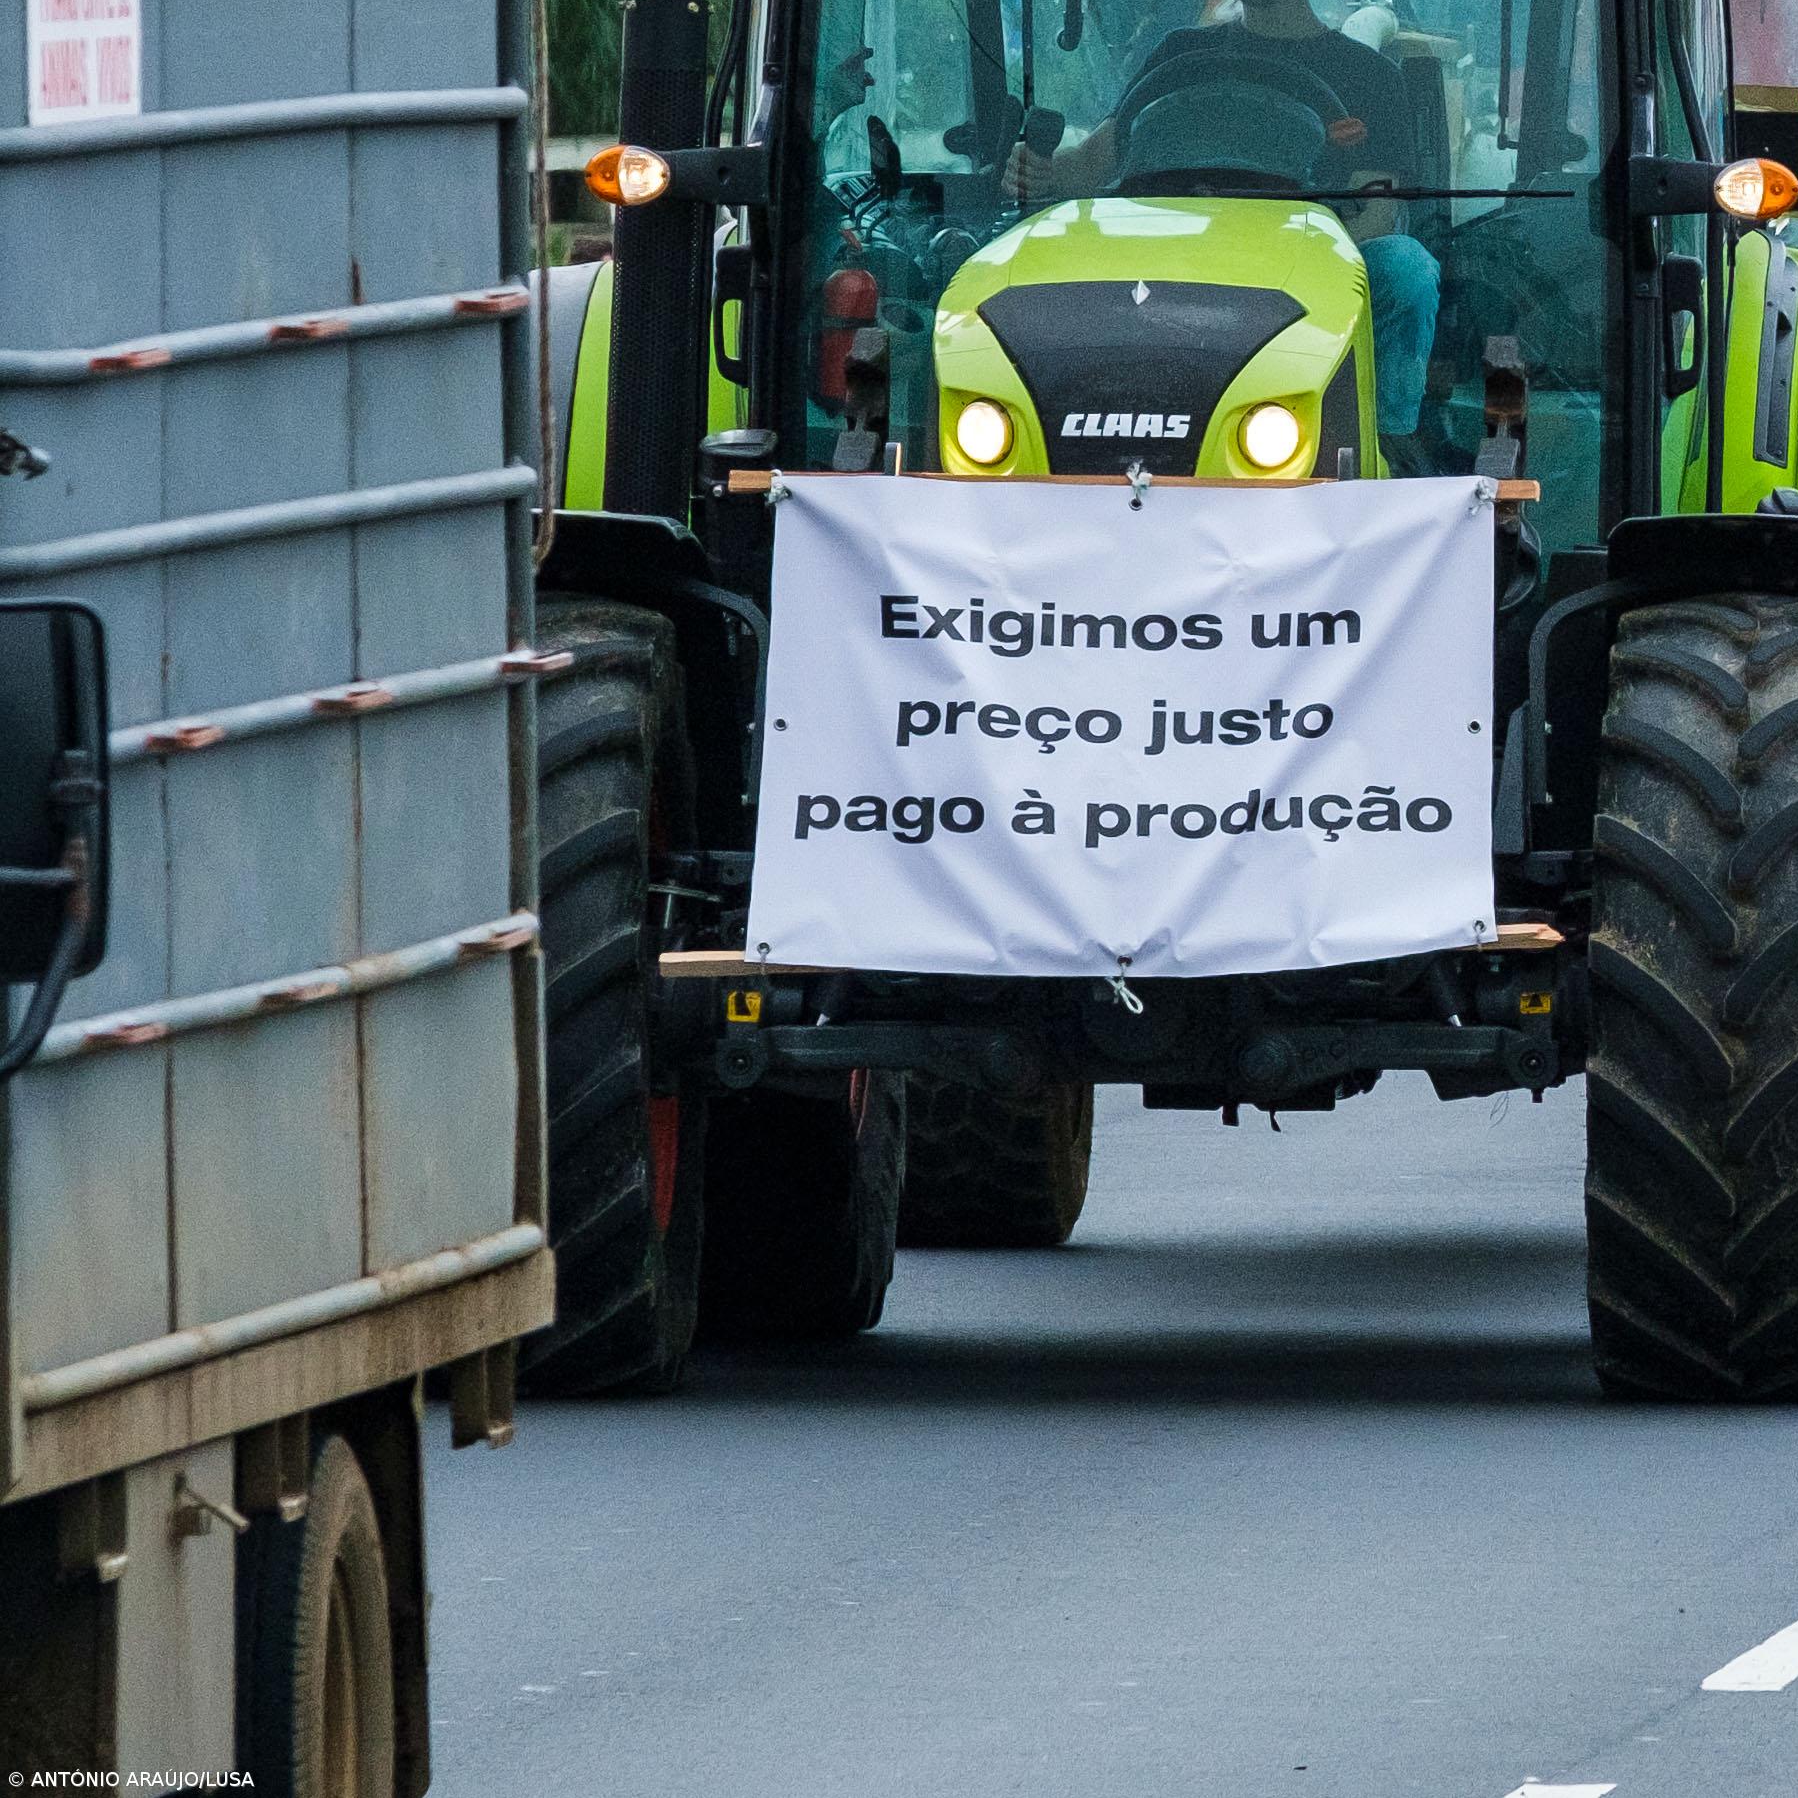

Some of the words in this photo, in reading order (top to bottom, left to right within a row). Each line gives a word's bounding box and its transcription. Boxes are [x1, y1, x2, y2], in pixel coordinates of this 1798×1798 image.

[1061, 412, 1191, 440] CLAAS
[880, 594, 1224, 658] Exigimos
[1251, 609, 1362, 649] um
[896, 700, 1123, 755] preço
[1144, 699, 1335, 756] justo
[795, 794, 986, 845] pago
[1011, 788, 1056, 836] à
[1085, 785, 1454, 849] produção
